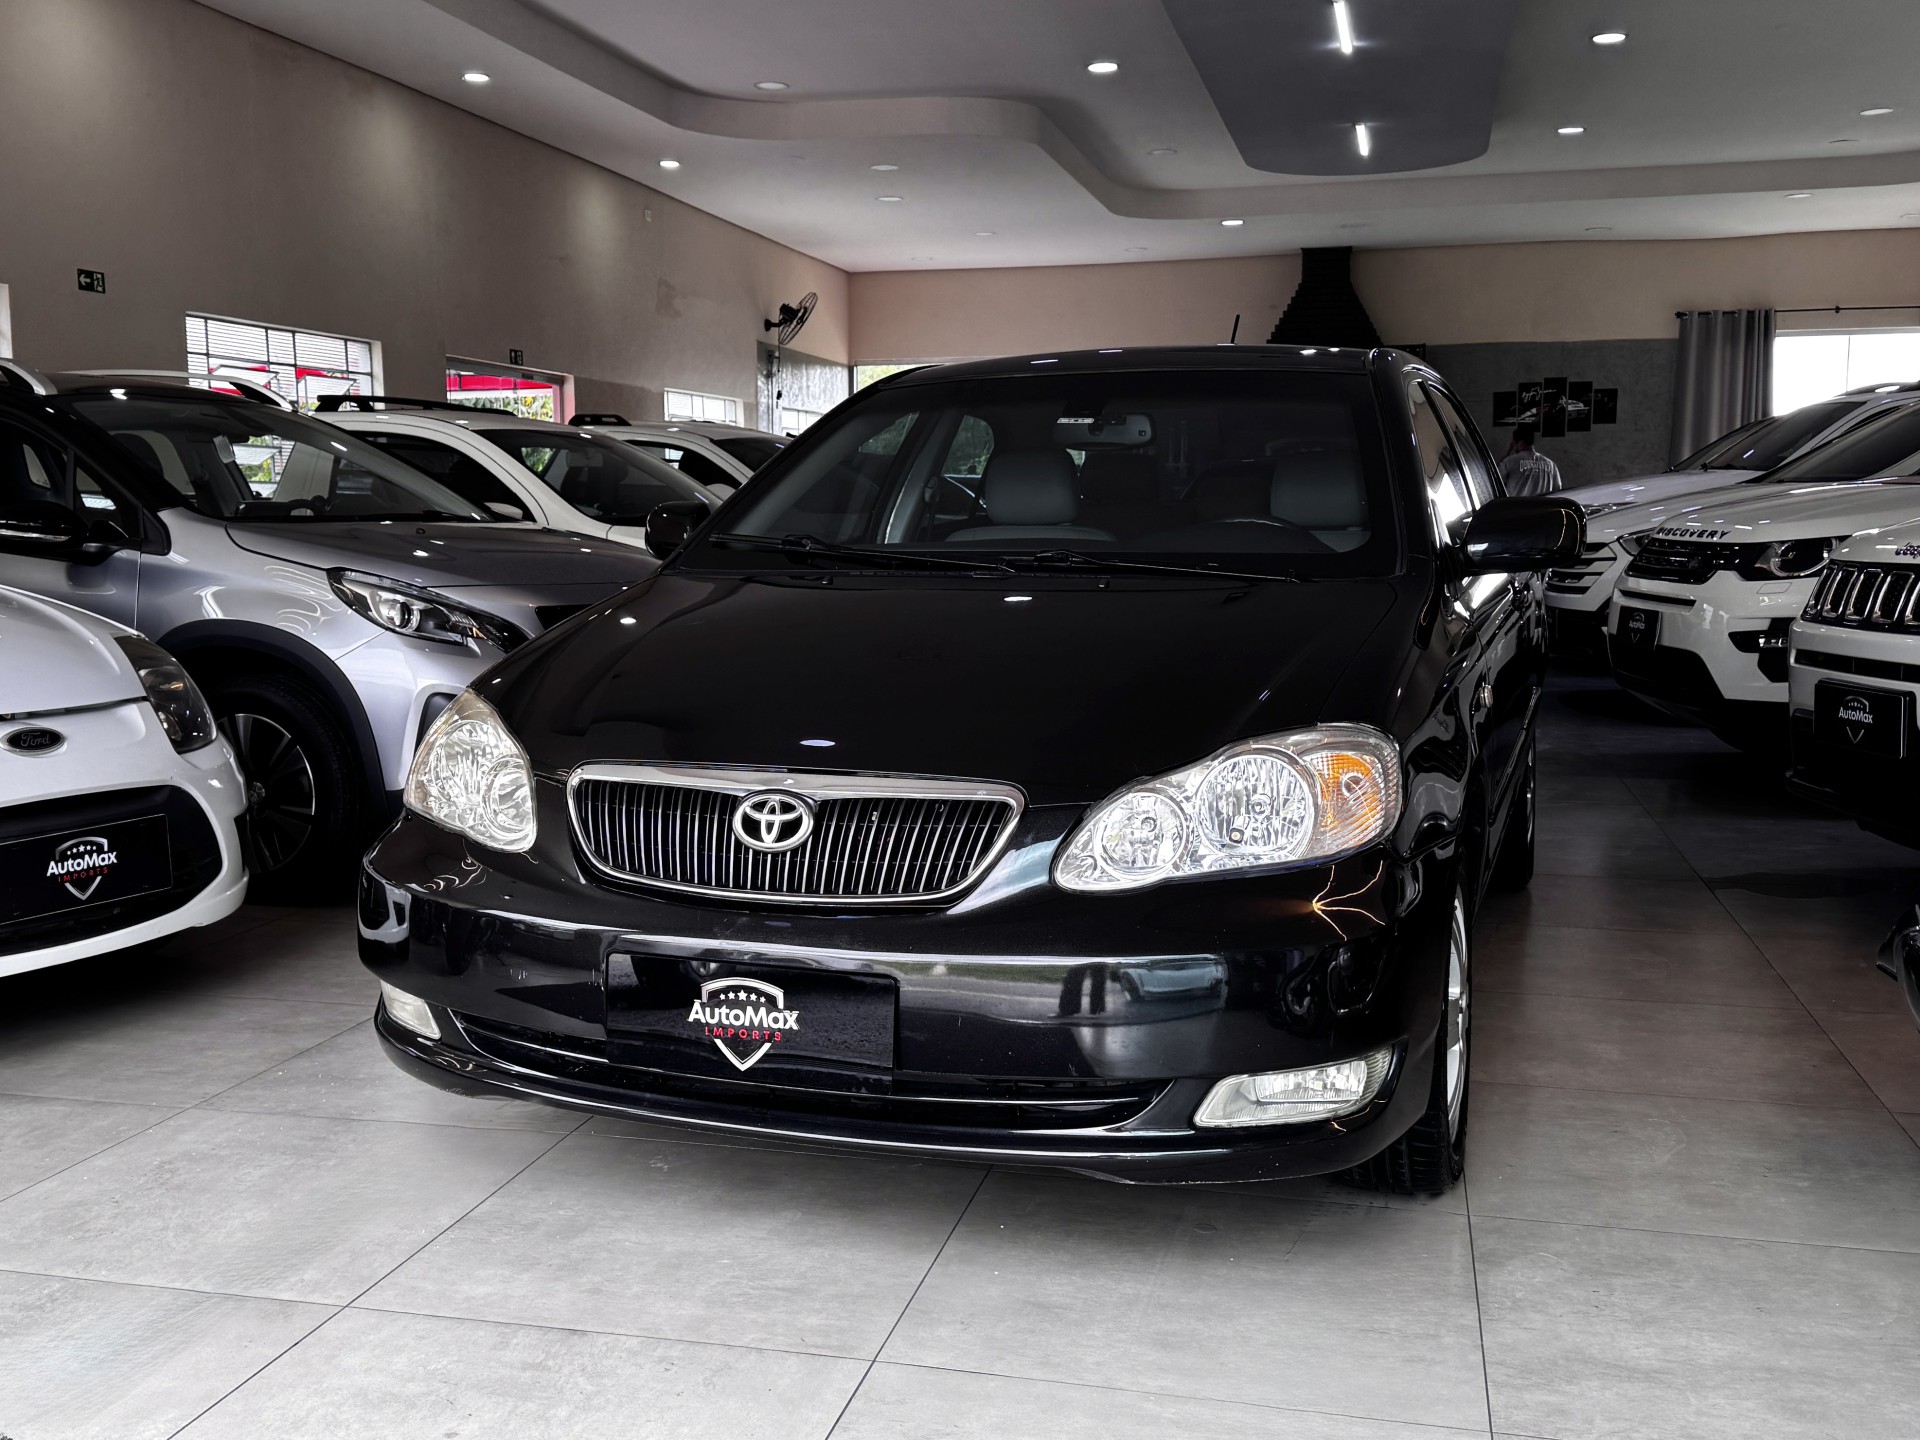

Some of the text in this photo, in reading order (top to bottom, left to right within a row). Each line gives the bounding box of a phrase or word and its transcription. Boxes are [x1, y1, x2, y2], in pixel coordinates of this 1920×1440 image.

[1656, 527, 1732, 540] DISCOVERY
[1838, 706, 1873, 724] AutoMax
[20, 732, 50, 747] Ford
[46, 851, 118, 877] AutoMax
[58, 867, 109, 883] IMPORTS
[687, 999, 800, 1030] AutoMax
[704, 1026, 782, 1042] IMPORTS
